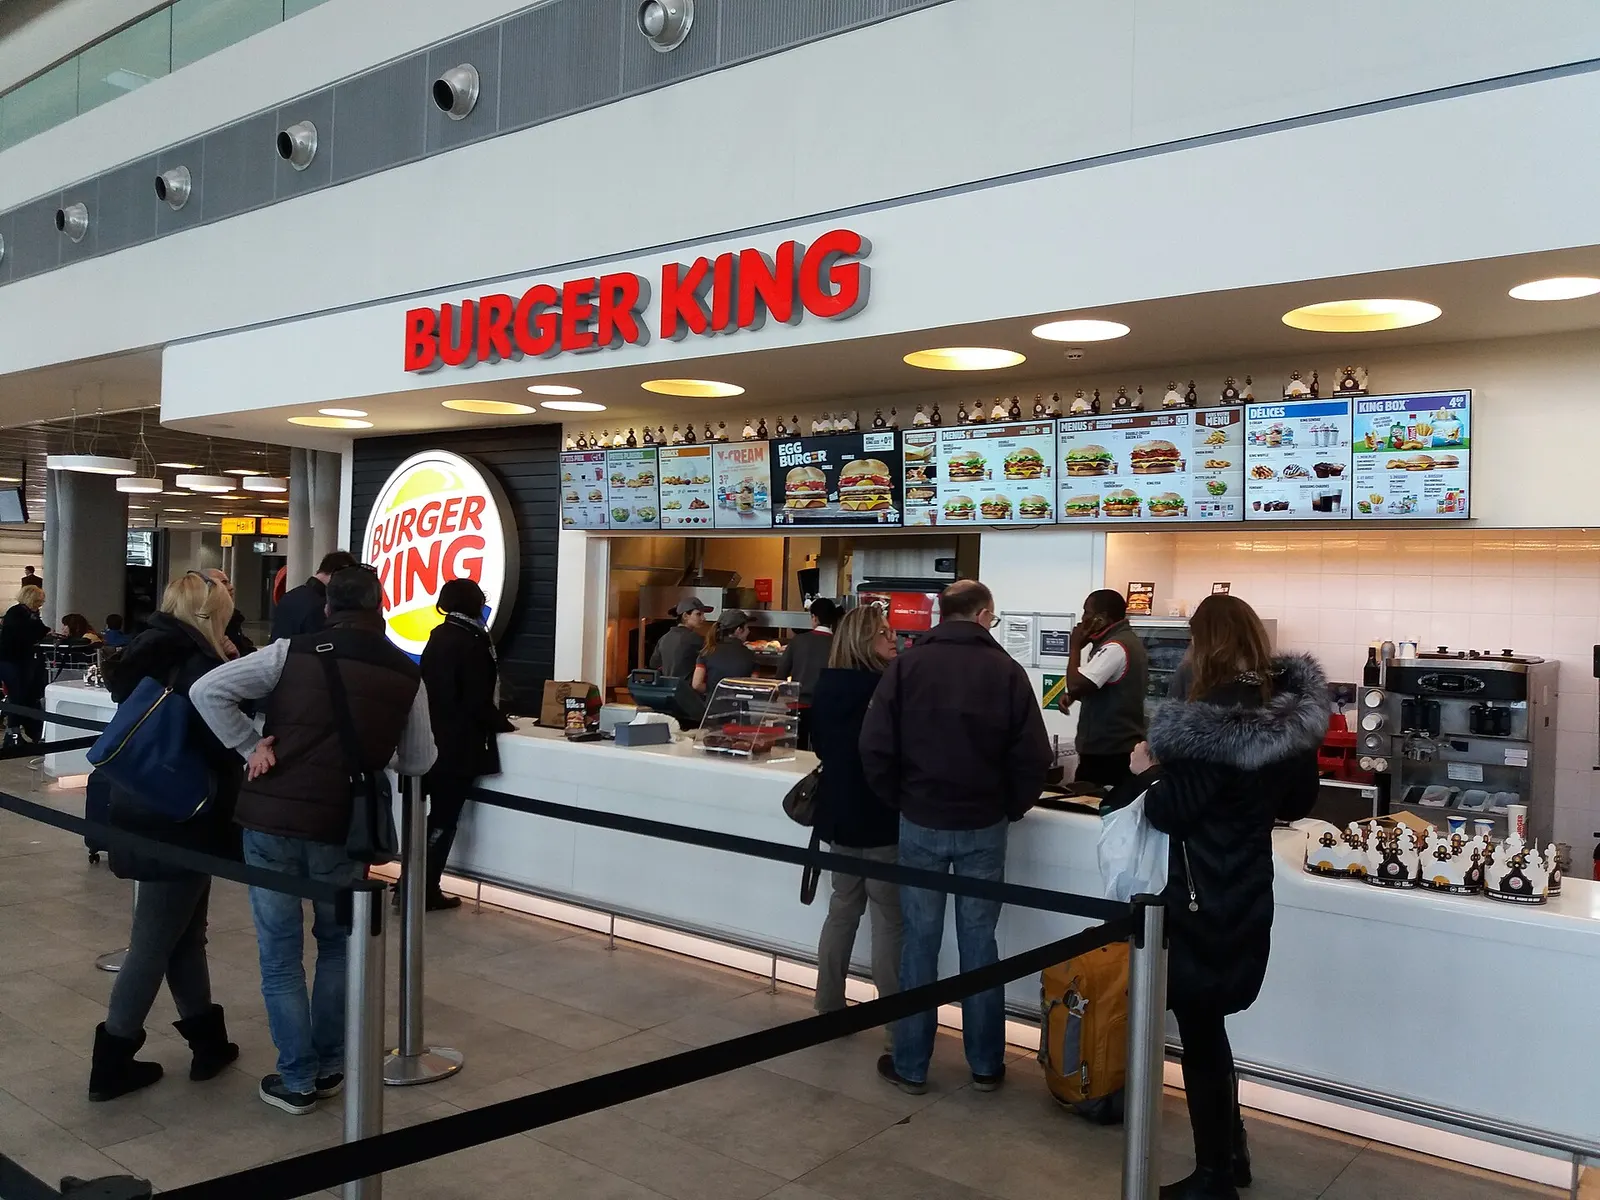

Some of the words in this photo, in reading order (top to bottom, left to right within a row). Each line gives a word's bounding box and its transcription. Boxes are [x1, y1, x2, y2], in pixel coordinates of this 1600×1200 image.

[405, 272, 645, 374] BURGER
[660, 229, 867, 340] KING
[1359, 400, 1384, 413] KING
[1385, 400, 1406, 411] BOX
[1061, 422, 1088, 432] MENUS
[1206, 416, 1230, 426] MENU
[943, 430, 966, 440] MENUS
[717, 448, 764, 464] Y-CREAM
[778, 442, 802, 456] EGG
[780, 450, 827, 468] BURGER
[371, 495, 486, 564] BURGER
[377, 535, 486, 612] KING
